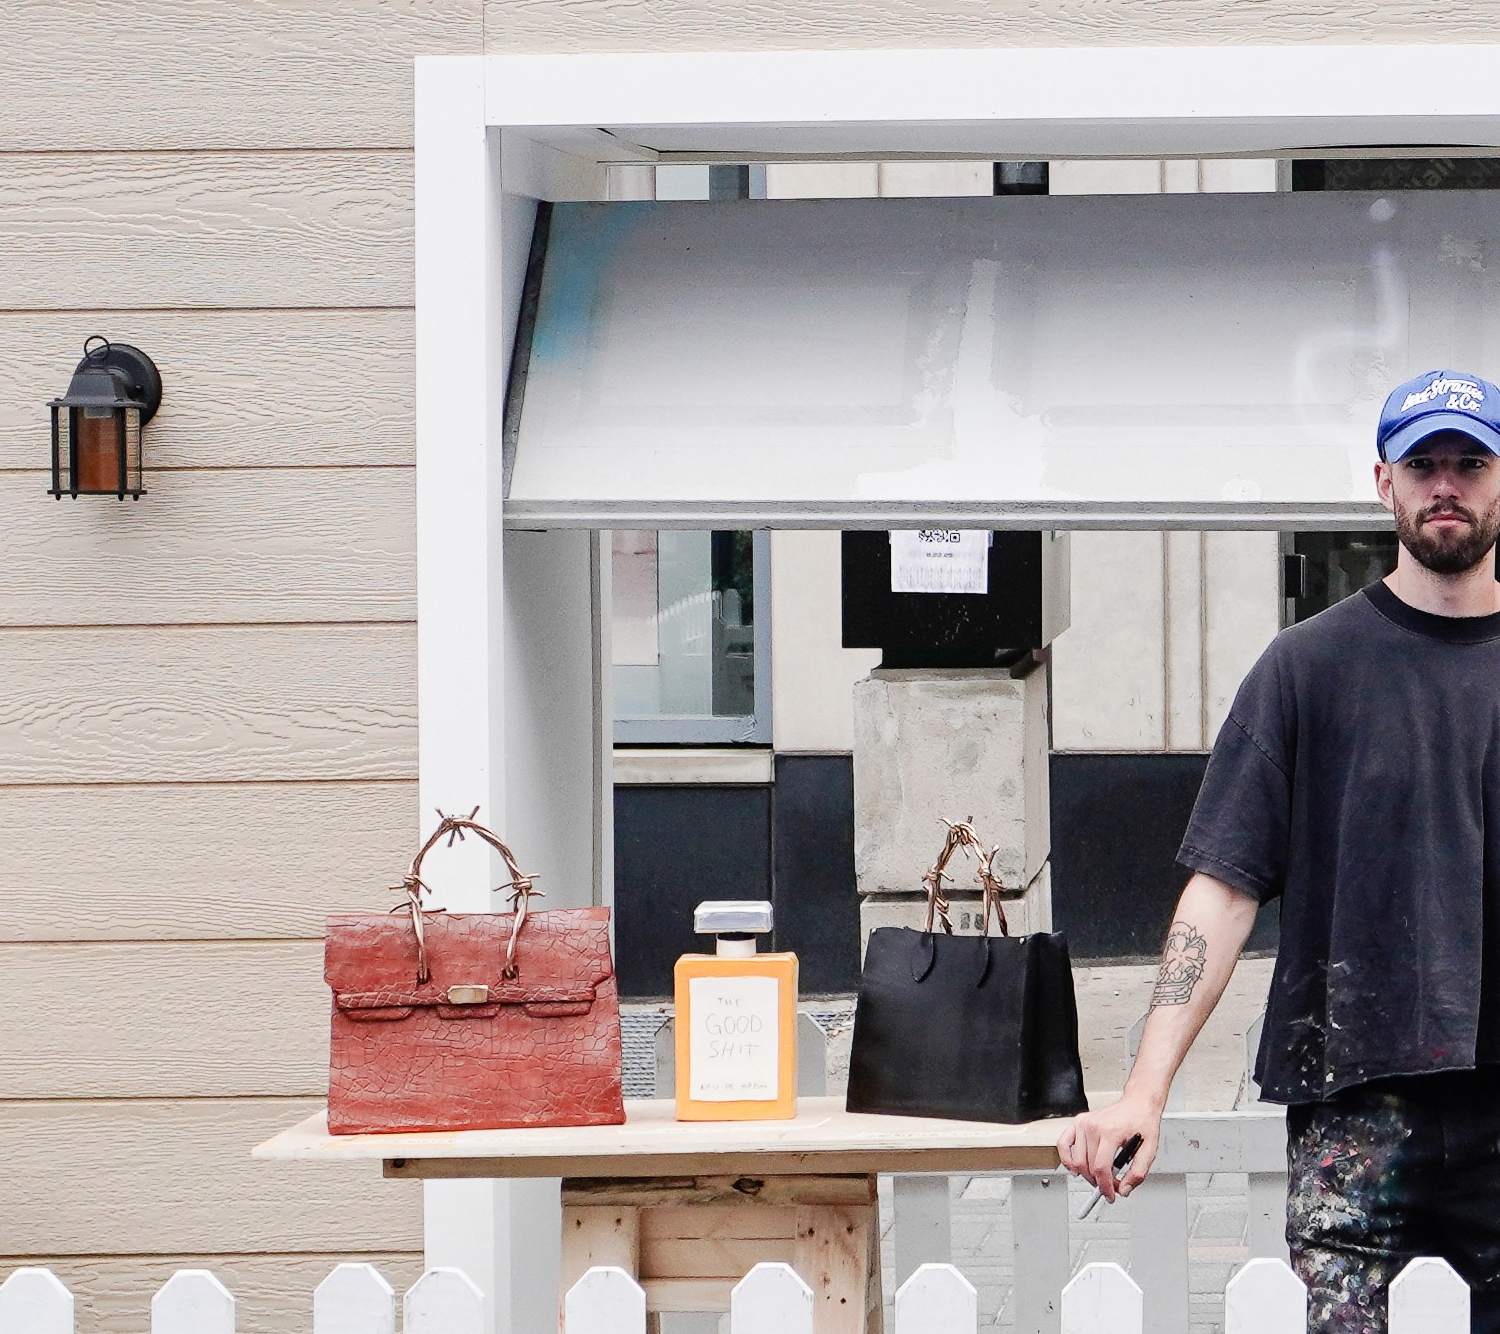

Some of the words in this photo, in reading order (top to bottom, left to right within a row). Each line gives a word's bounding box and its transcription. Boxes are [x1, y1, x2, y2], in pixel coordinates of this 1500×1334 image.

[717, 997, 741, 1007] THE
[706, 1013, 762, 1035] GOOD
[709, 1040, 759, 1058] SHIT
